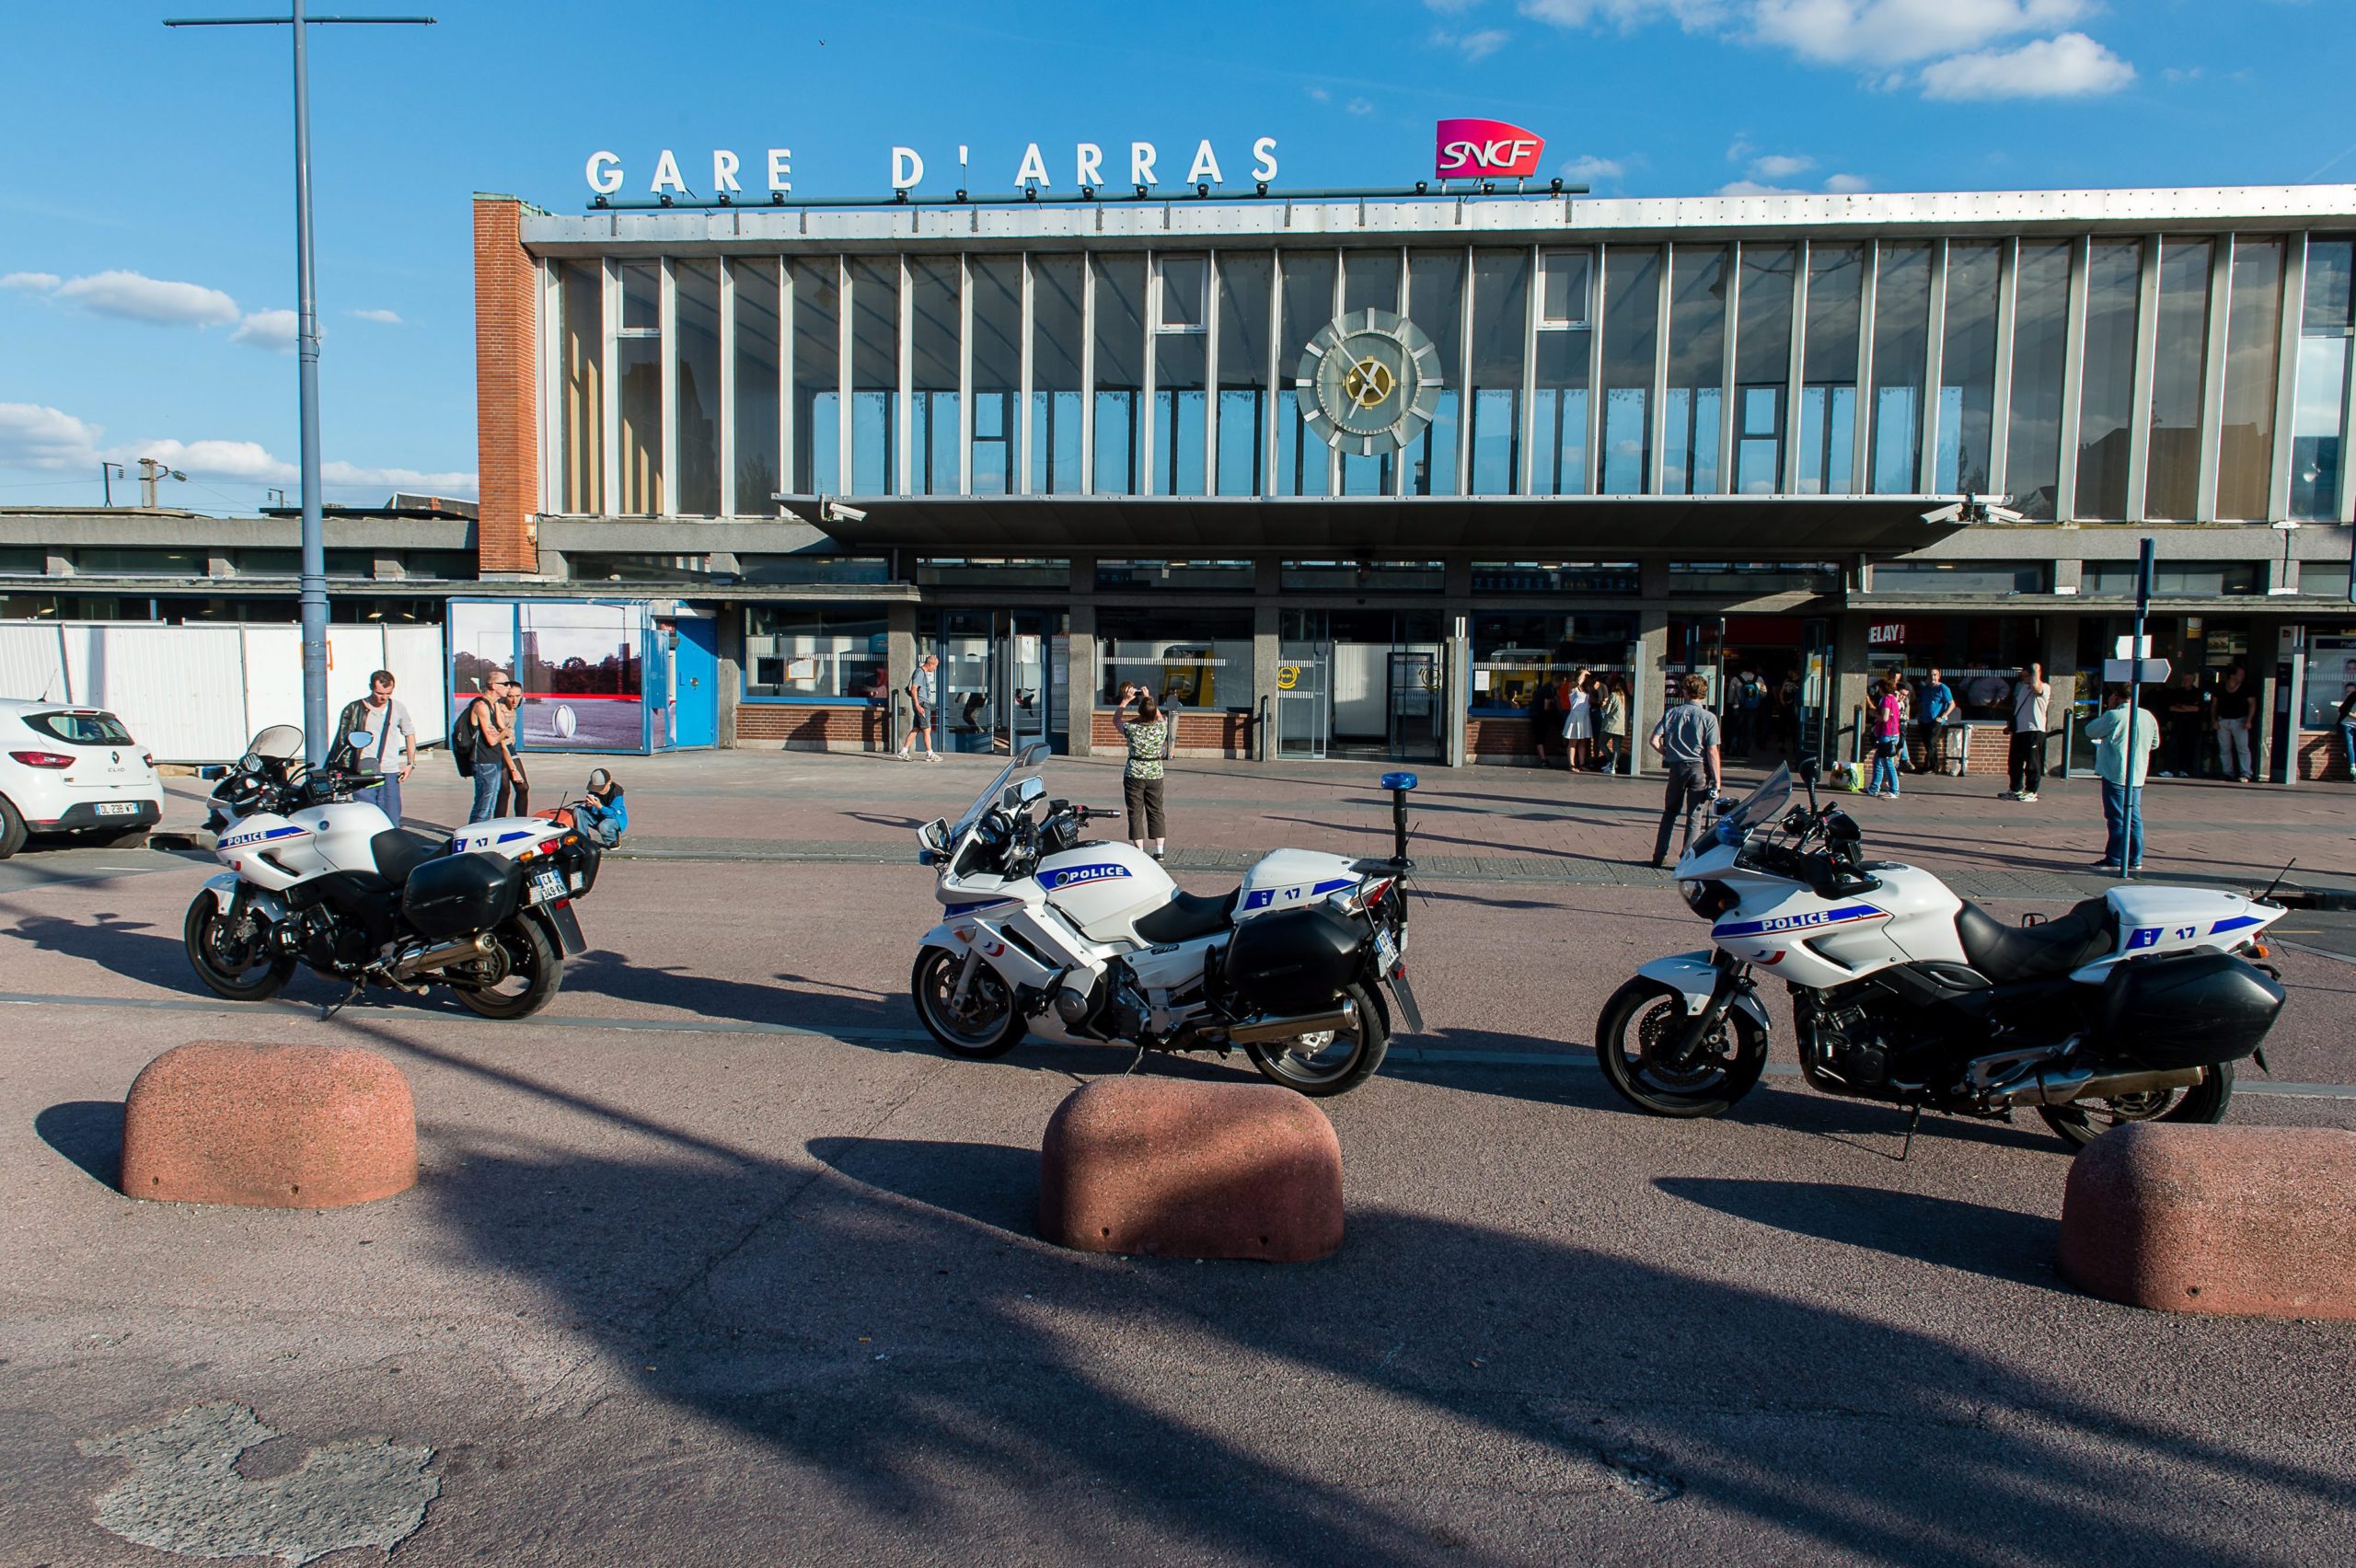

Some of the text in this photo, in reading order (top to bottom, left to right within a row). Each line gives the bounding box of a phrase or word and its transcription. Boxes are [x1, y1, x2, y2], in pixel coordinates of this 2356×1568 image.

[1439, 140, 1537, 169] SNCF
[585, 149, 791, 194] GARE
[1868, 625, 1899, 643] ELAY
[227, 831, 267, 846] POLICE
[475, 837, 489, 847] 17
[1069, 867, 1125, 882] POLICE
[1285, 887, 1300, 900] 17
[1761, 910, 1830, 931] POLICE
[2176, 926, 2196, 940] 17
